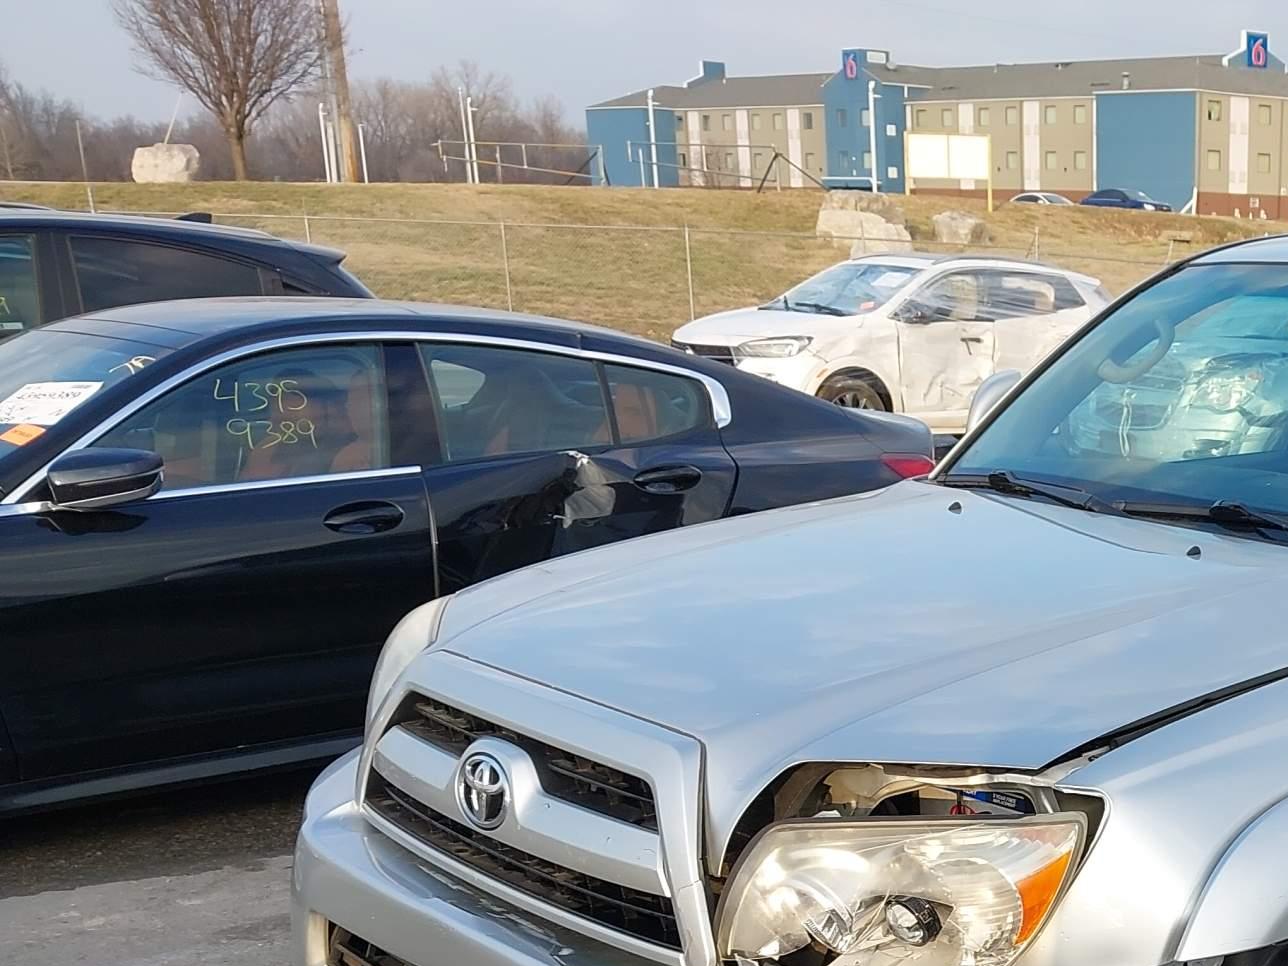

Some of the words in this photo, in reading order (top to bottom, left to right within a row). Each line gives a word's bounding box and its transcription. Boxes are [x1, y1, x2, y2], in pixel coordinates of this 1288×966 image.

[846, 53, 857, 78] 6
[1251, 38, 1265, 65] 6
[213, 378, 307, 412] 4395
[226, 418, 318, 449] 9389
